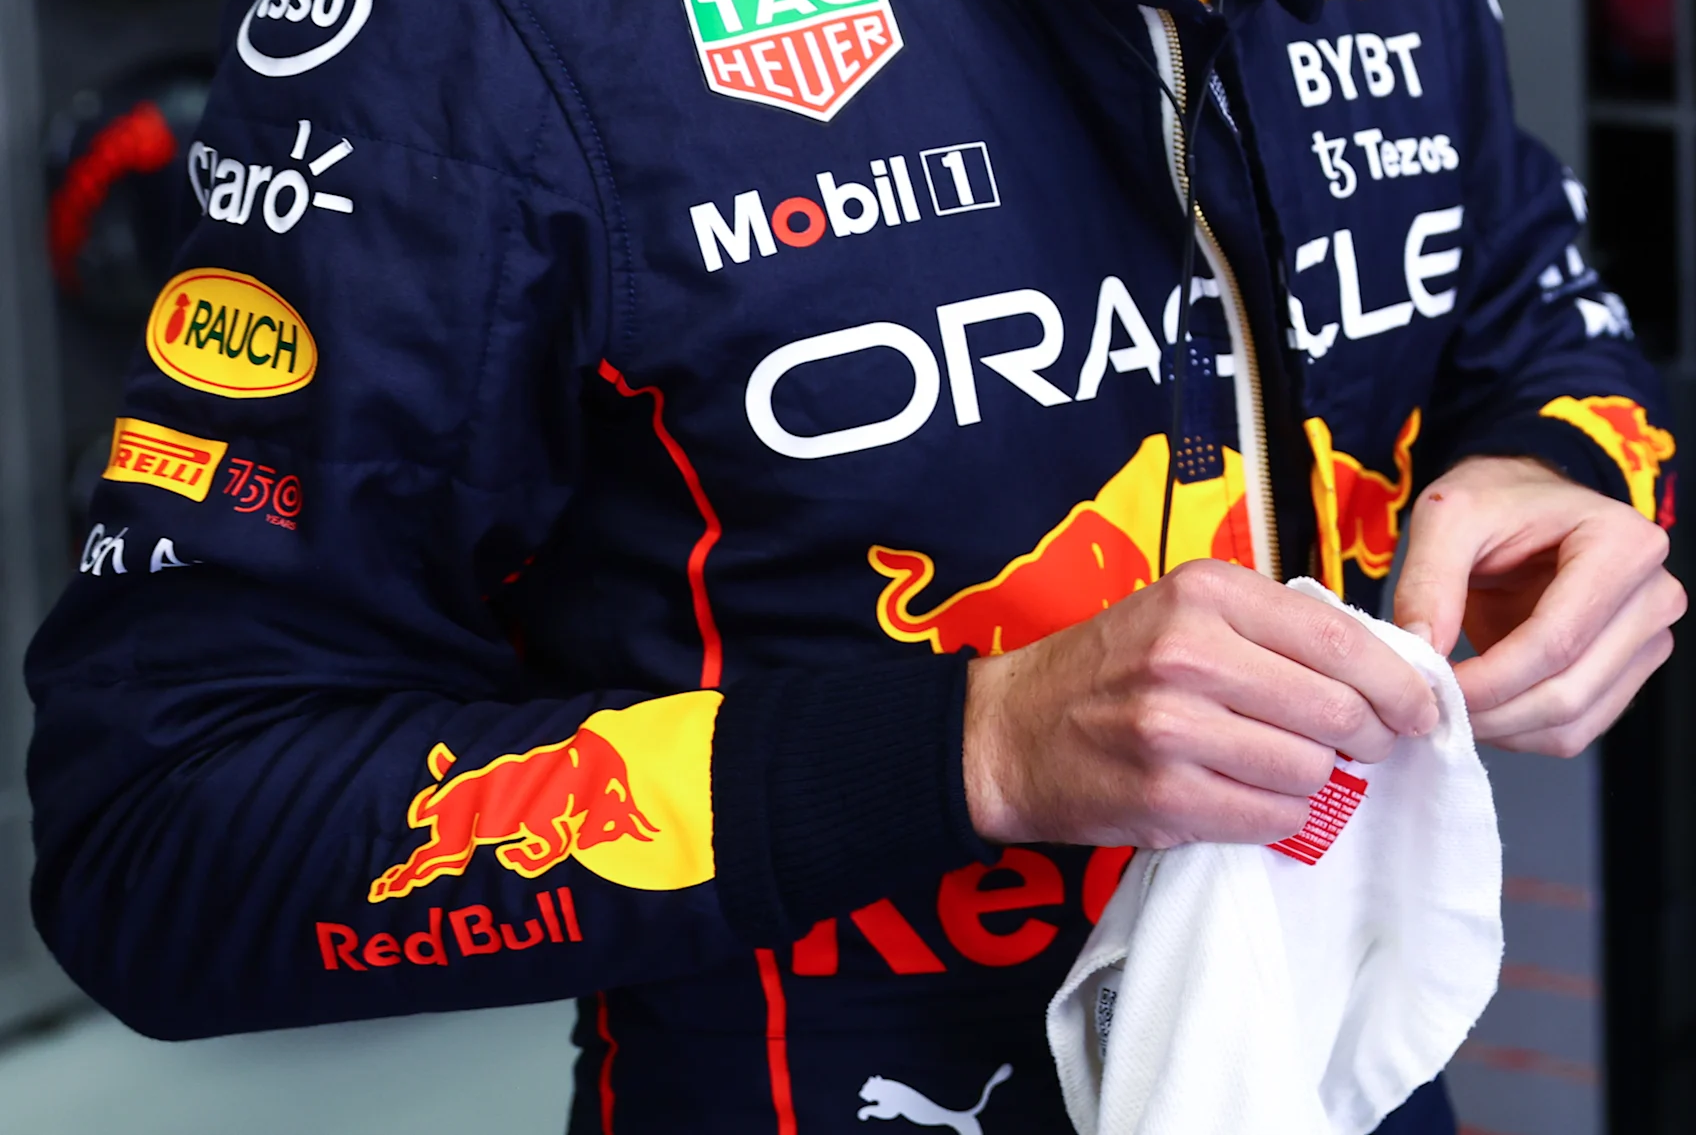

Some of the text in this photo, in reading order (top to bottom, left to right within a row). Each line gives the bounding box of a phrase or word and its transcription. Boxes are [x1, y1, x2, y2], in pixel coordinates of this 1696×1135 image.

[712, 16, 887, 107] HEUER
[1287, 32, 1423, 108] BYBT
[1353, 127, 1460, 181] Tezos
[689, 155, 922, 272] Mobil
[185, 299, 298, 373] RAUCH
[745, 205, 1464, 459] ORACLE
[115, 448, 303, 518] RELLI 150
[265, 514, 297, 531] YEARS
[315, 886, 583, 971] Red Bull
